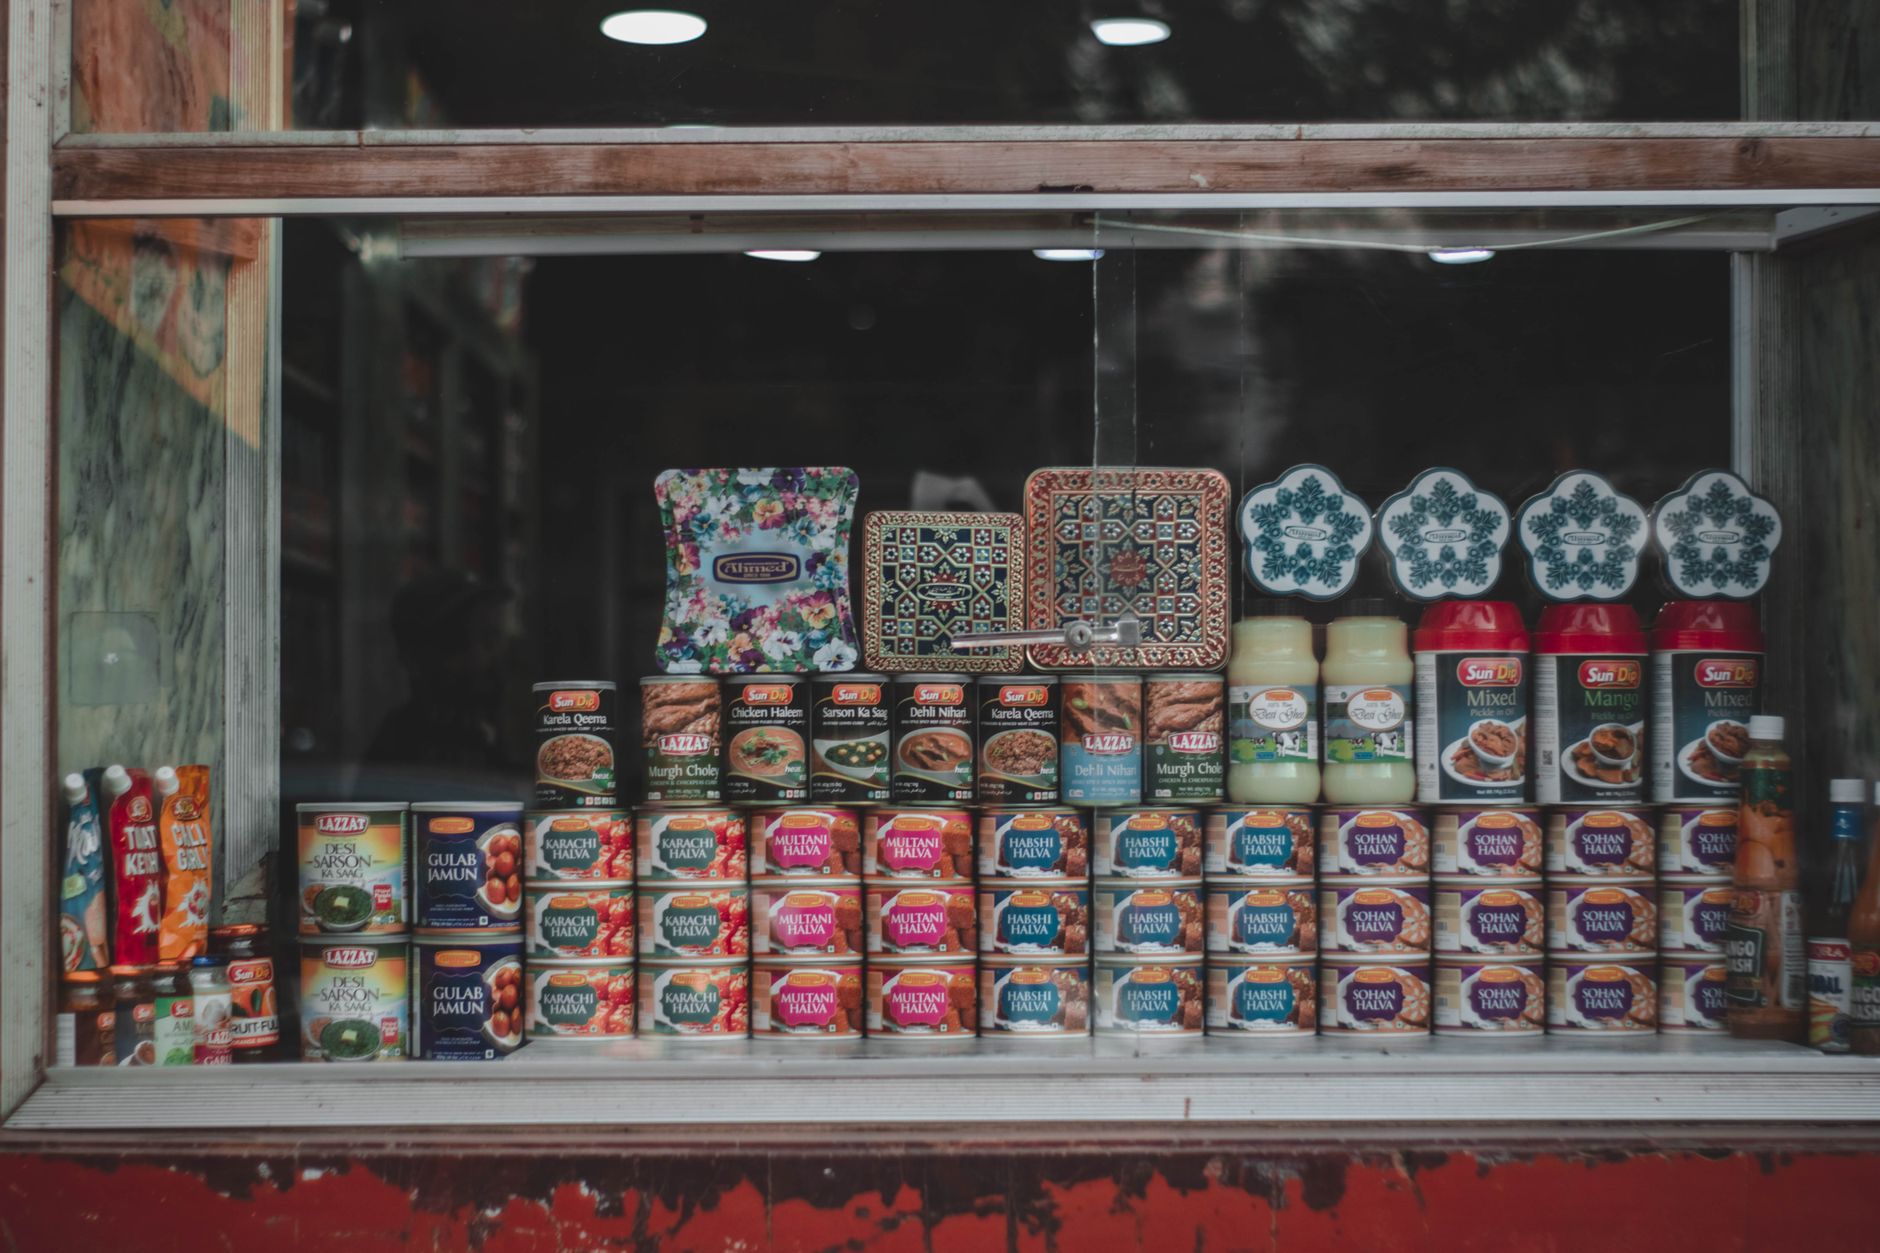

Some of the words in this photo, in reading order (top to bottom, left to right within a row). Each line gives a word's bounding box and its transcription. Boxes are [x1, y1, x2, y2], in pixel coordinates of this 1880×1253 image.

[724, 561, 789, 573] Ahmed
[1467, 665, 1493, 680] Sun
[1497, 664, 1517, 680] Dip
[1587, 668, 1614, 682] Sun
[1617, 666, 1637, 682] Dip
[1704, 667, 1730, 681] Sun
[1735, 667, 1753, 682] Dip
[749, 690, 767, 700] Sun
[770, 690, 787, 701] Dip
[838, 690, 857, 700] Sun
[861, 689, 876, 701] Dip
[920, 690, 938, 700] Sun
[942, 689, 958, 701] Dip
[1006, 691, 1024, 701] Sun
[1028, 690, 1043, 701] Dip
[1467, 689, 1516, 706] Mixed
[1585, 691, 1638, 710] Mango
[1705, 691, 1752, 706] Mixed
[555, 696, 574, 707] Sun
[577, 695, 595, 708] Dip
[732, 707, 767, 718] Chicken
[771, 707, 803, 717] Haleem
[823, 707, 855, 717] Sarson
[858, 707, 870, 717] Ka
[872, 708, 888, 720] Saag
[910, 707, 935, 717] Dehli
[939, 707, 966, 717] Nihari
[992, 708, 1021, 719] Karela
[1025, 708, 1053, 720] Qeema
[1470, 709, 1494, 717] Pickle
[544, 714, 571, 724] Karela
[574, 714, 607, 725] Qeema
[661, 736, 708, 750] LAZZAT
[1085, 736, 1133, 750] LAZZAT
[1172, 734, 1218, 749] LAZZAT
[649, 767, 682, 779] Murgh
[687, 765, 719, 779] Choley
[1076, 765, 1103, 776] Dehli
[1157, 763, 1194, 777] Murgh
[319, 816, 367, 832] LAZZAT
[546, 838, 597, 850] KARACHI
[663, 838, 714, 849] KARACHI
[775, 835, 827, 845] MULTANI
[887, 837, 939, 848] MULTANI
[1010, 838, 1053, 848] HABSHI
[1126, 837, 1169, 848] HABSHI
[1242, 835, 1285, 845] HABSHI
[1355, 834, 1397, 845] SOHAN
[1475, 835, 1517, 845] SOHAN
[1582, 834, 1624, 844] SOHAN
[325, 844, 356, 854] DESI
[553, 849, 590, 860] HALVA
[669, 848, 707, 859] HALVA
[784, 845, 821, 856] HALVA
[894, 848, 932, 859] HALVA
[1014, 847, 1051, 858] HALVA
[1129, 847, 1166, 858] HALVA
[1246, 845, 1283, 856] HALVA
[1358, 844, 1396, 855] HALVA
[1478, 845, 1515, 855] HALVA
[1585, 844, 1622, 855] HALVA
[314, 855, 371, 868] SARSON
[428, 854, 477, 867] GULAB
[322, 869, 336, 878] KA
[337, 868, 364, 878] SAAG
[428, 868, 477, 882] JAMUN
[544, 916, 595, 927] KARACHI
[666, 915, 717, 926] KARACHI
[780, 914, 832, 924] MULTANI
[891, 912, 943, 923] MULTANI
[1008, 914, 1051, 924] HABSHI
[1129, 913, 1172, 924] HABSHI
[1244, 913, 1287, 923] HABSHI
[1353, 911, 1395, 922] SOHAN
[1478, 913, 1520, 923] SOHAN
[1583, 911, 1625, 922] SOHAN
[551, 926, 588, 937] HALVA
[673, 925, 710, 936] HALVA
[788, 924, 825, 935] HALVA
[900, 922, 937, 934] HALVA
[1012, 923, 1048, 935] HALVA
[1133, 922, 1170, 934] HALVA
[1248, 923, 1285, 934] HALVA
[1356, 921, 1393, 932] HALVA
[1481, 922, 1518, 933] HALVA
[1586, 921, 1624, 932] HALVA
[326, 949, 375, 965] LAZZAT
[234, 967, 253, 981] Sun
[332, 977, 365, 987] DESI
[320, 988, 379, 1001] SARSON
[433, 987, 483, 1000] GULAB
[544, 993, 594, 1005] KARACHI
[666, 992, 717, 1002] KARACHI
[782, 992, 834, 1003] MULTANI
[893, 992, 945, 1003] MULTANI
[1008, 991, 1051, 1001] HABSHI
[1128, 990, 1171, 1000] HABSHI
[1243, 990, 1287, 1000] HABSHI
[1353, 989, 1395, 1000] SOHAN
[1478, 988, 1520, 999] SOHAN
[1582, 988, 1625, 999] SOHAN
[329, 1001, 343, 1011] KA
[344, 1001, 371, 1012] SAAG
[433, 1001, 484, 1016] JAMUN
[550, 1003, 586, 1015] HALVA
[673, 1002, 710, 1013] HALVA
[790, 1002, 827, 1014] HALVA
[901, 1002, 938, 1013] HALVA
[1012, 1000, 1048, 1011] HALVA
[1131, 1000, 1168, 1011] HALVA
[1247, 1000, 1284, 1011] HALVA
[1356, 1000, 1394, 1011] HALVA
[1482, 998, 1518, 1009] HALVA
[1586, 998, 1623, 1009] HALVA
